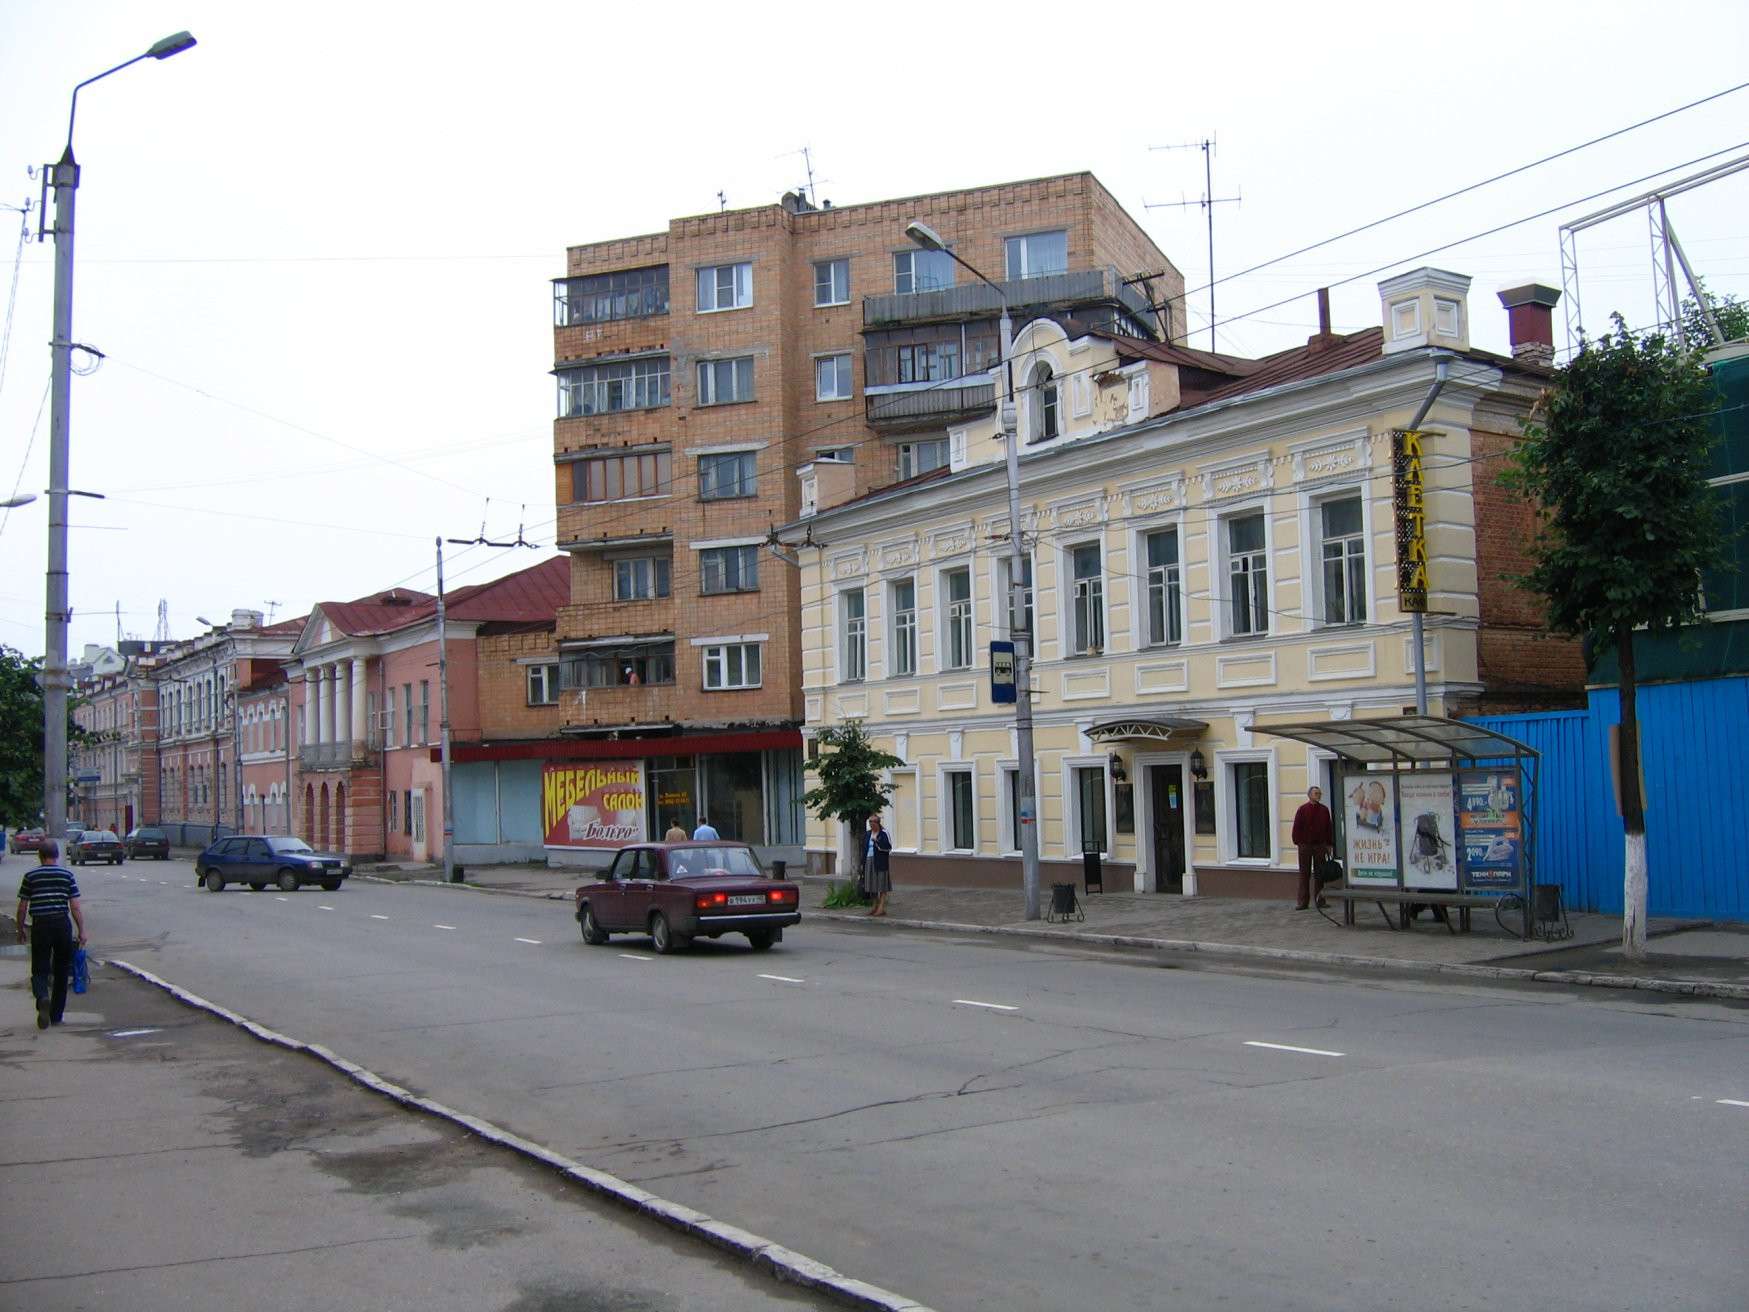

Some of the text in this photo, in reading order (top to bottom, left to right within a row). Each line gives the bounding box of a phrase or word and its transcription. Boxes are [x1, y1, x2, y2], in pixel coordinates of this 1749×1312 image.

[544, 767, 640, 839] МЕБЕЛЬНЫЙ
[603, 793, 644, 811] САЛОН
[1353, 839, 1383, 850] ЖИЗНЬ
[1355, 852, 1390, 864] НЕ ИГРА!
